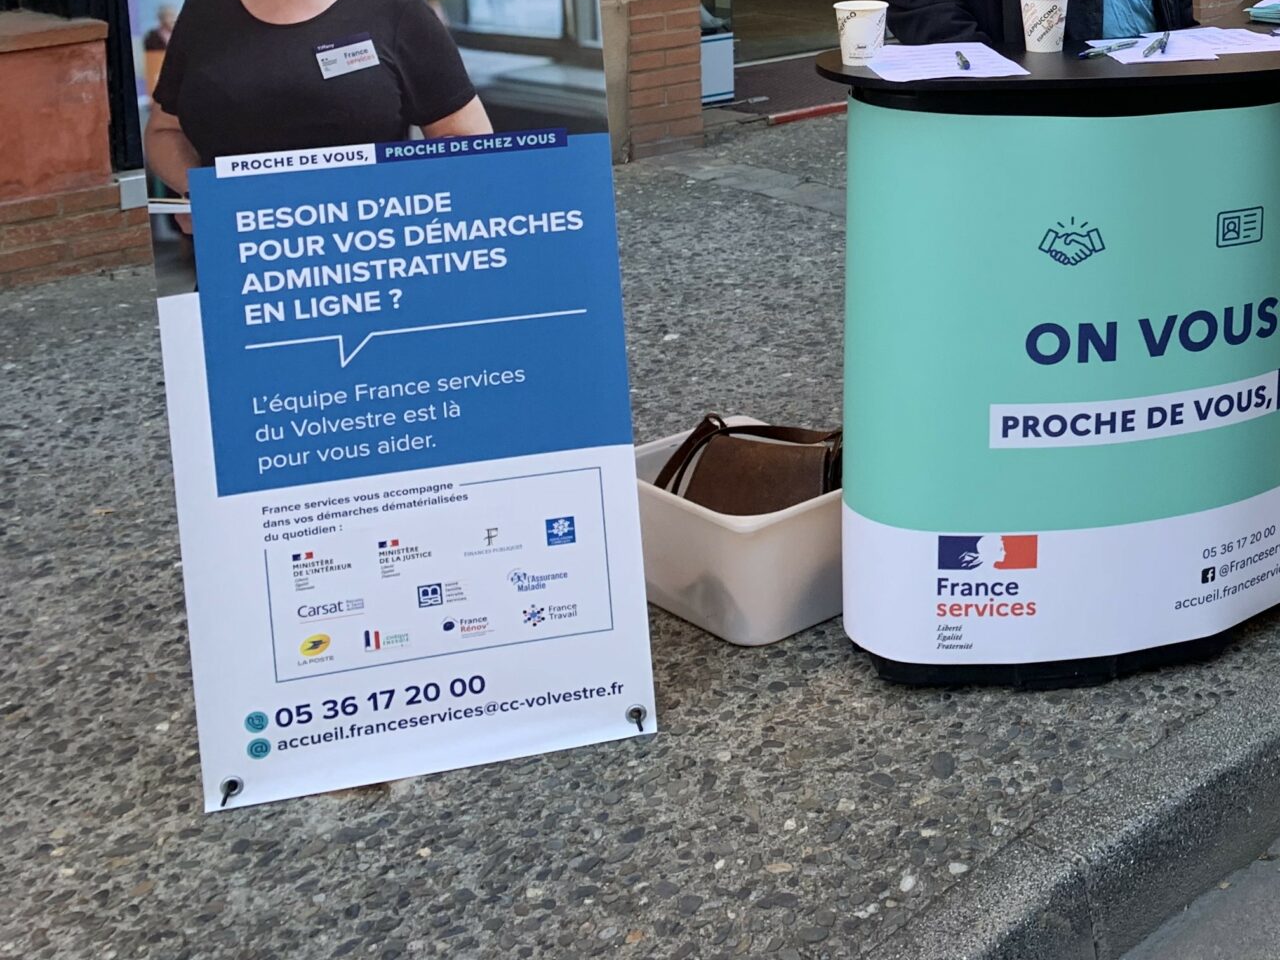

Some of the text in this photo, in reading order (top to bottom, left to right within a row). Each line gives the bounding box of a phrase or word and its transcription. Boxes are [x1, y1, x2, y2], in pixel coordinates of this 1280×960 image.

[344, 48, 369, 59] France
[231, 132, 557, 172] PROCHE DE VOUS, PROCHE DE CHEZ VOUS
[236, 192, 452, 233] BESOIN D’AIDE
[238, 210, 585, 264] POUR VOS DÉMARCHES
[241, 247, 508, 296] ADMINISTRATIVES
[244, 288, 404, 326] EN LIGNE ?
[1025, 321, 1118, 366] ON
[1138, 296, 1279, 358] VOUS
[252, 368, 527, 415] L’équipe France services
[255, 400, 462, 443] du Volvestre est là
[1001, 408, 1136, 439] PROCHE
[1147, 402, 1184, 430] DE
[1193, 384, 1273, 422] VOUS,
[258, 433, 437, 475] pour vous aider.
[261, 481, 454, 516] France services vous accompagne
[263, 493, 469, 529] dans vos démarches dématérialisées
[264, 532, 279, 543] du
[282, 523, 337, 542] quotidien
[1203, 546, 1217, 560] 05
[1220, 541, 1234, 555] 36
[1236, 537, 1247, 550] 17
[1249, 531, 1262, 545] 20
[1264, 525, 1276, 539] 00
[378, 546, 420, 557] MINISTÈRE
[379, 551, 433, 565] DE LA JUSTICE
[464, 543, 523, 558] FINANCES PUBLIQUES
[292, 558, 335, 570] MINISTÈRE
[305, 563, 352, 576] L'INTÉRIEUR
[517, 582, 547, 592] Maladie
[527, 571, 569, 584] l'Assurance
[937, 577, 1020, 597] France
[297, 599, 344, 618] Carsat
[548, 603, 578, 612] France
[549, 610, 578, 620] Travail
[936, 597, 1037, 618] services
[460, 615, 488, 625] France
[460, 622, 490, 633] Rénov'
[936, 624, 963, 632] Liberté
[936, 632, 963, 642] Égalité
[936, 642, 973, 650] Fraternité
[297, 655, 335, 667] LA POSTE
[274, 675, 486, 729] 05 36 17 20 00
[276, 681, 625, 752] accueil.franceservices@cc-volvestre.fr
